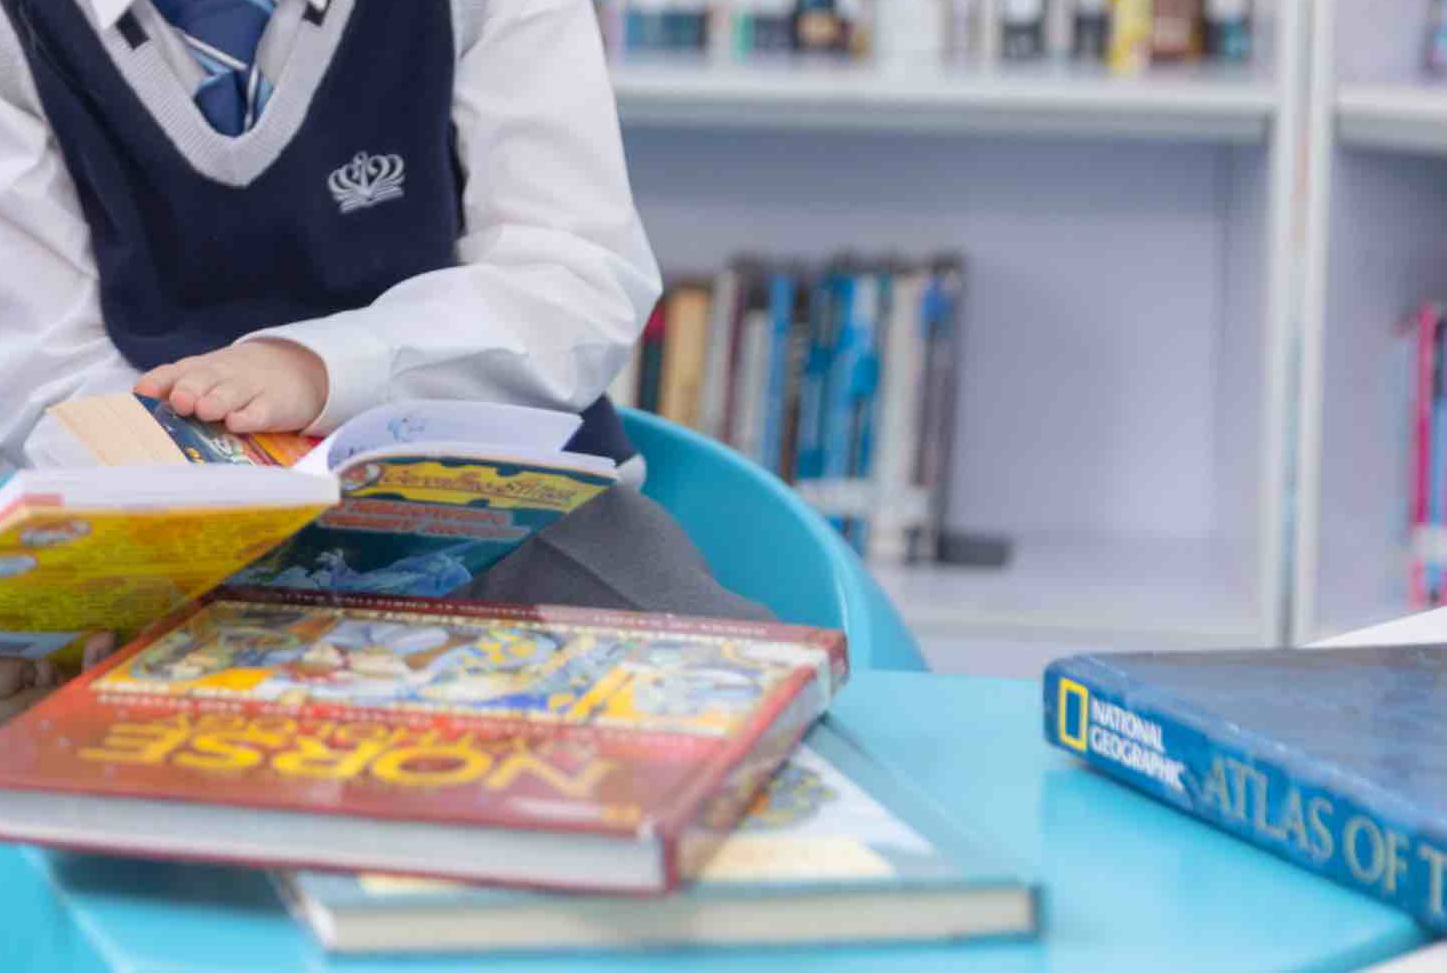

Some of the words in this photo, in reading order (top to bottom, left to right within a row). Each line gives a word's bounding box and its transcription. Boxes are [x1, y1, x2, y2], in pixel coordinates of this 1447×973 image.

[76, 717, 619, 798] NORSE
[1090, 724, 1186, 793] GEOGRAPHIC
[1091, 696, 1164, 754] NATIONAL
[1202, 754, 1334, 862] ATLAS
[1343, 814, 1411, 894] OF
